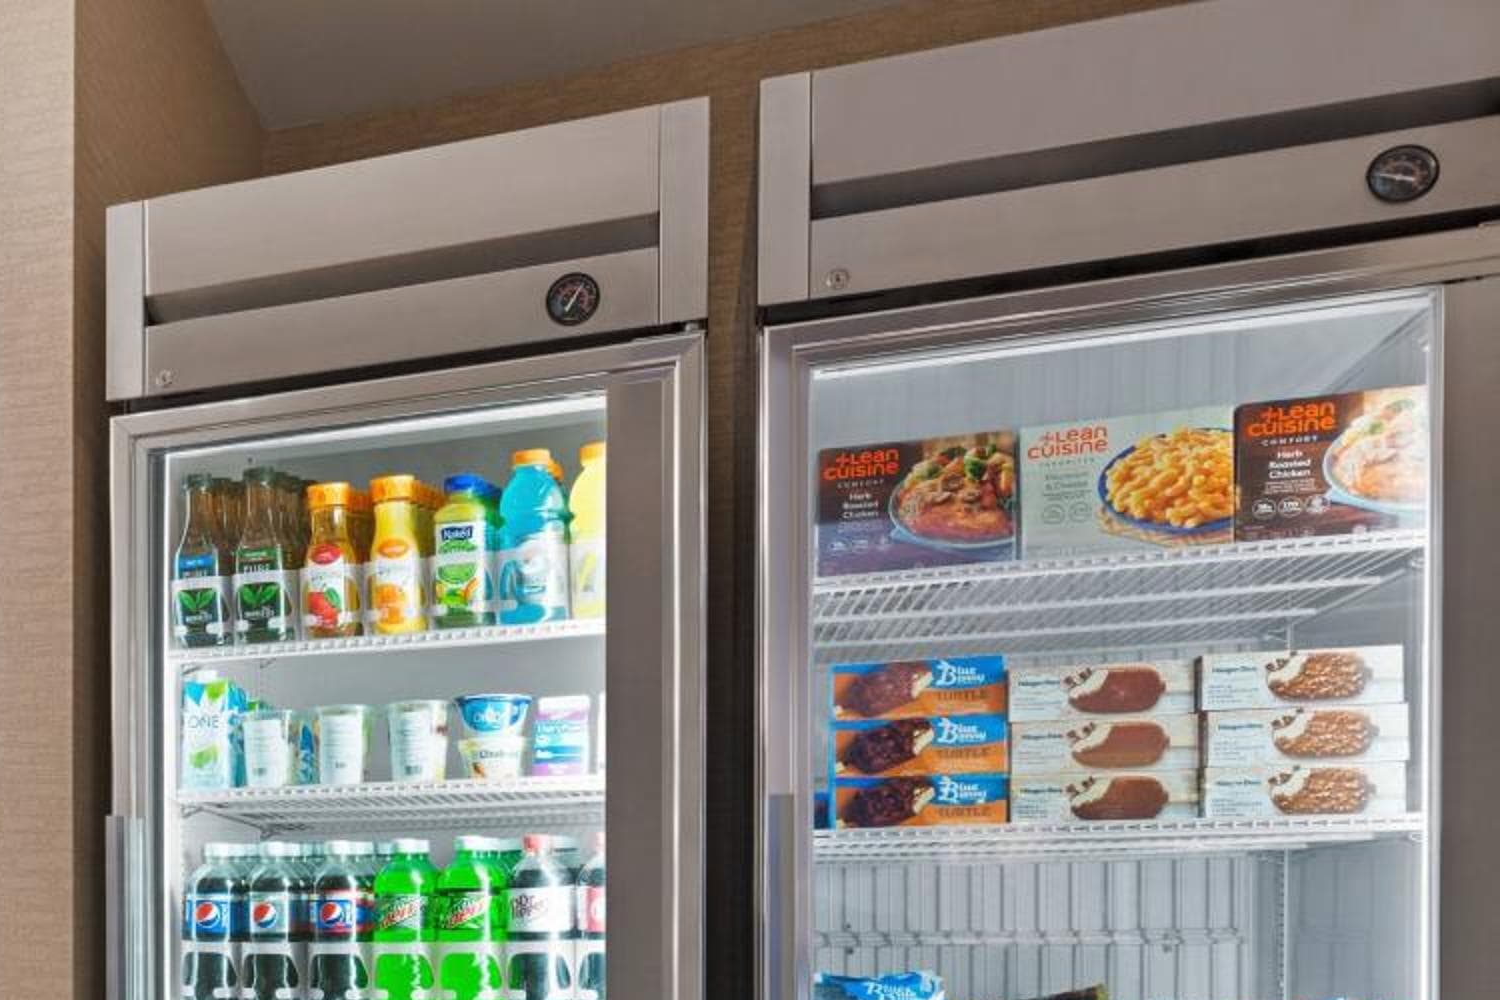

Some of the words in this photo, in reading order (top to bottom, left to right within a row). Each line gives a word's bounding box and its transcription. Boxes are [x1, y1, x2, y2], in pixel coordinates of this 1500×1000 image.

[1280, 402, 1335, 419] Lean
[1056, 426, 1107, 442] Lean
[1247, 416, 1335, 436] cuisine
[1028, 440, 1108, 459] cuisine
[1261, 436, 1317, 447] COMFORT
[851, 449, 899, 465] Lean
[823, 462, 899, 480] cuisine
[187, 714, 220, 729] ONE
